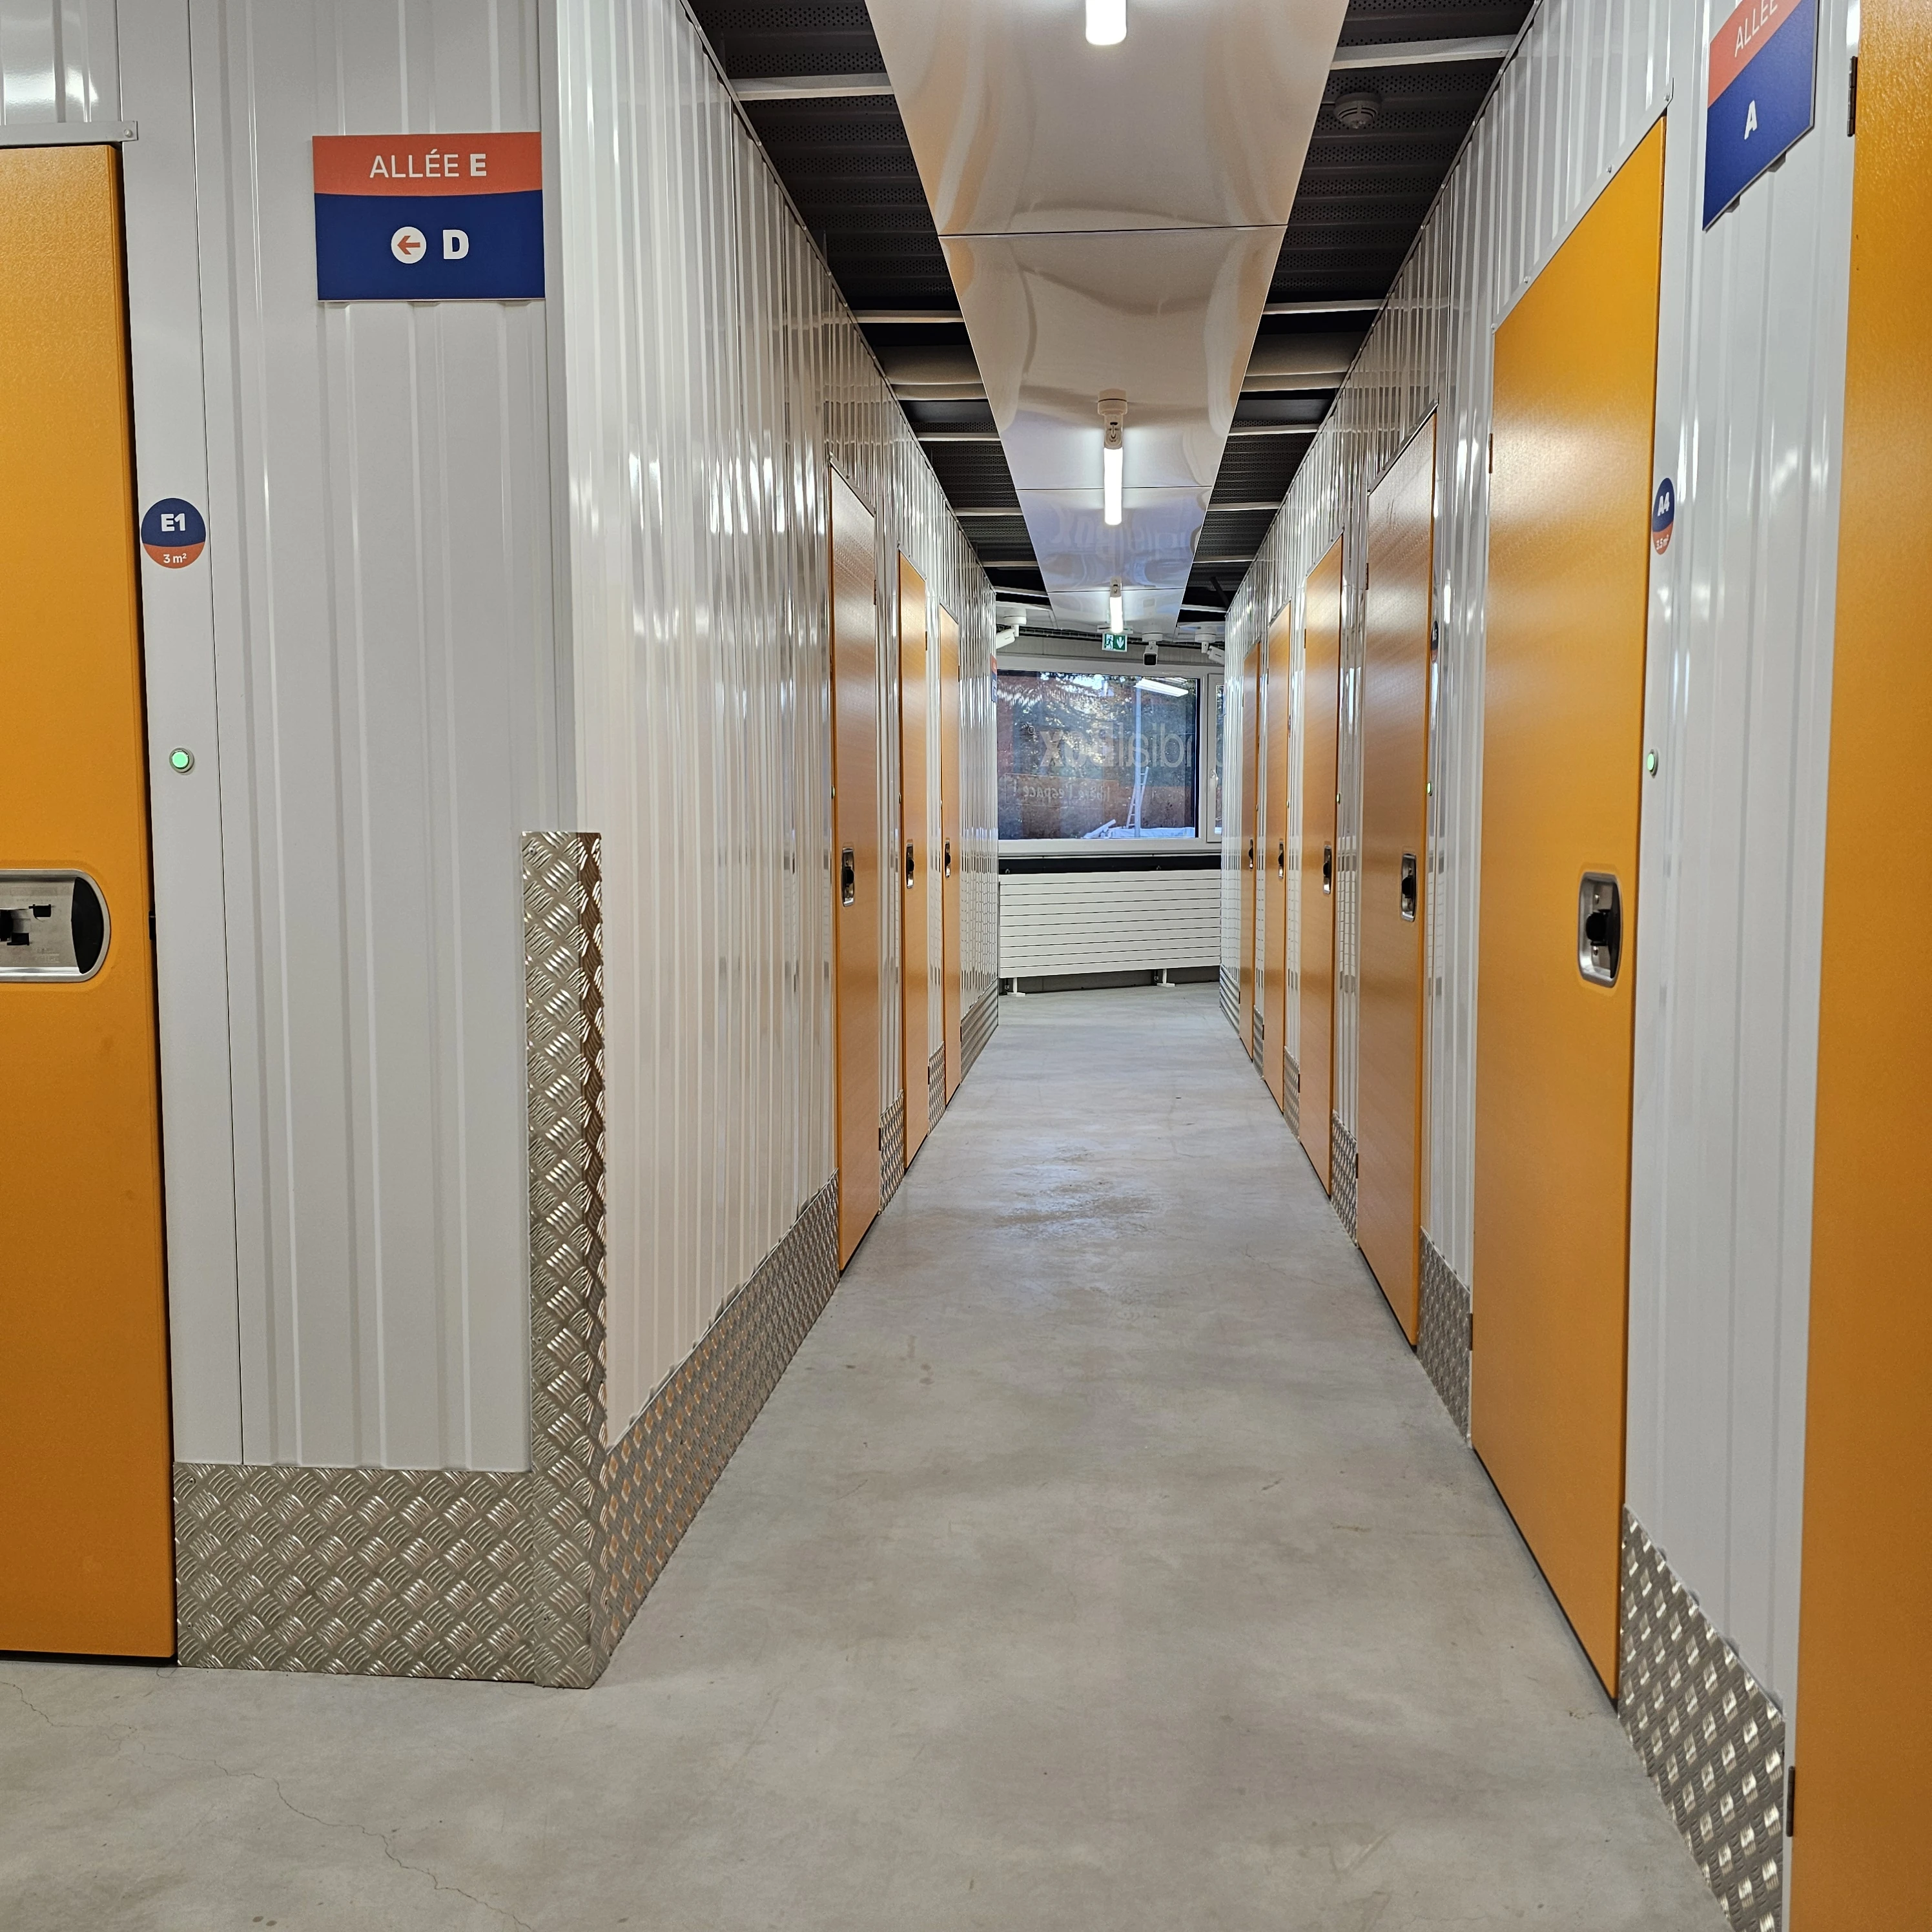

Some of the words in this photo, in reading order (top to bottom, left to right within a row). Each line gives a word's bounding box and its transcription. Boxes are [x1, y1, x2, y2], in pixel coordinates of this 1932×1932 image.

[1744, 100, 1757, 139] A
[369, 149, 459, 178] ALLÉE
[470, 153, 487, 176] E
[442, 229, 469, 260] D
[1658, 492, 1670, 517] A4
[161, 513, 186, 532] E1
[163, 553, 170, 564] 3
[172, 553, 187, 564] m²
